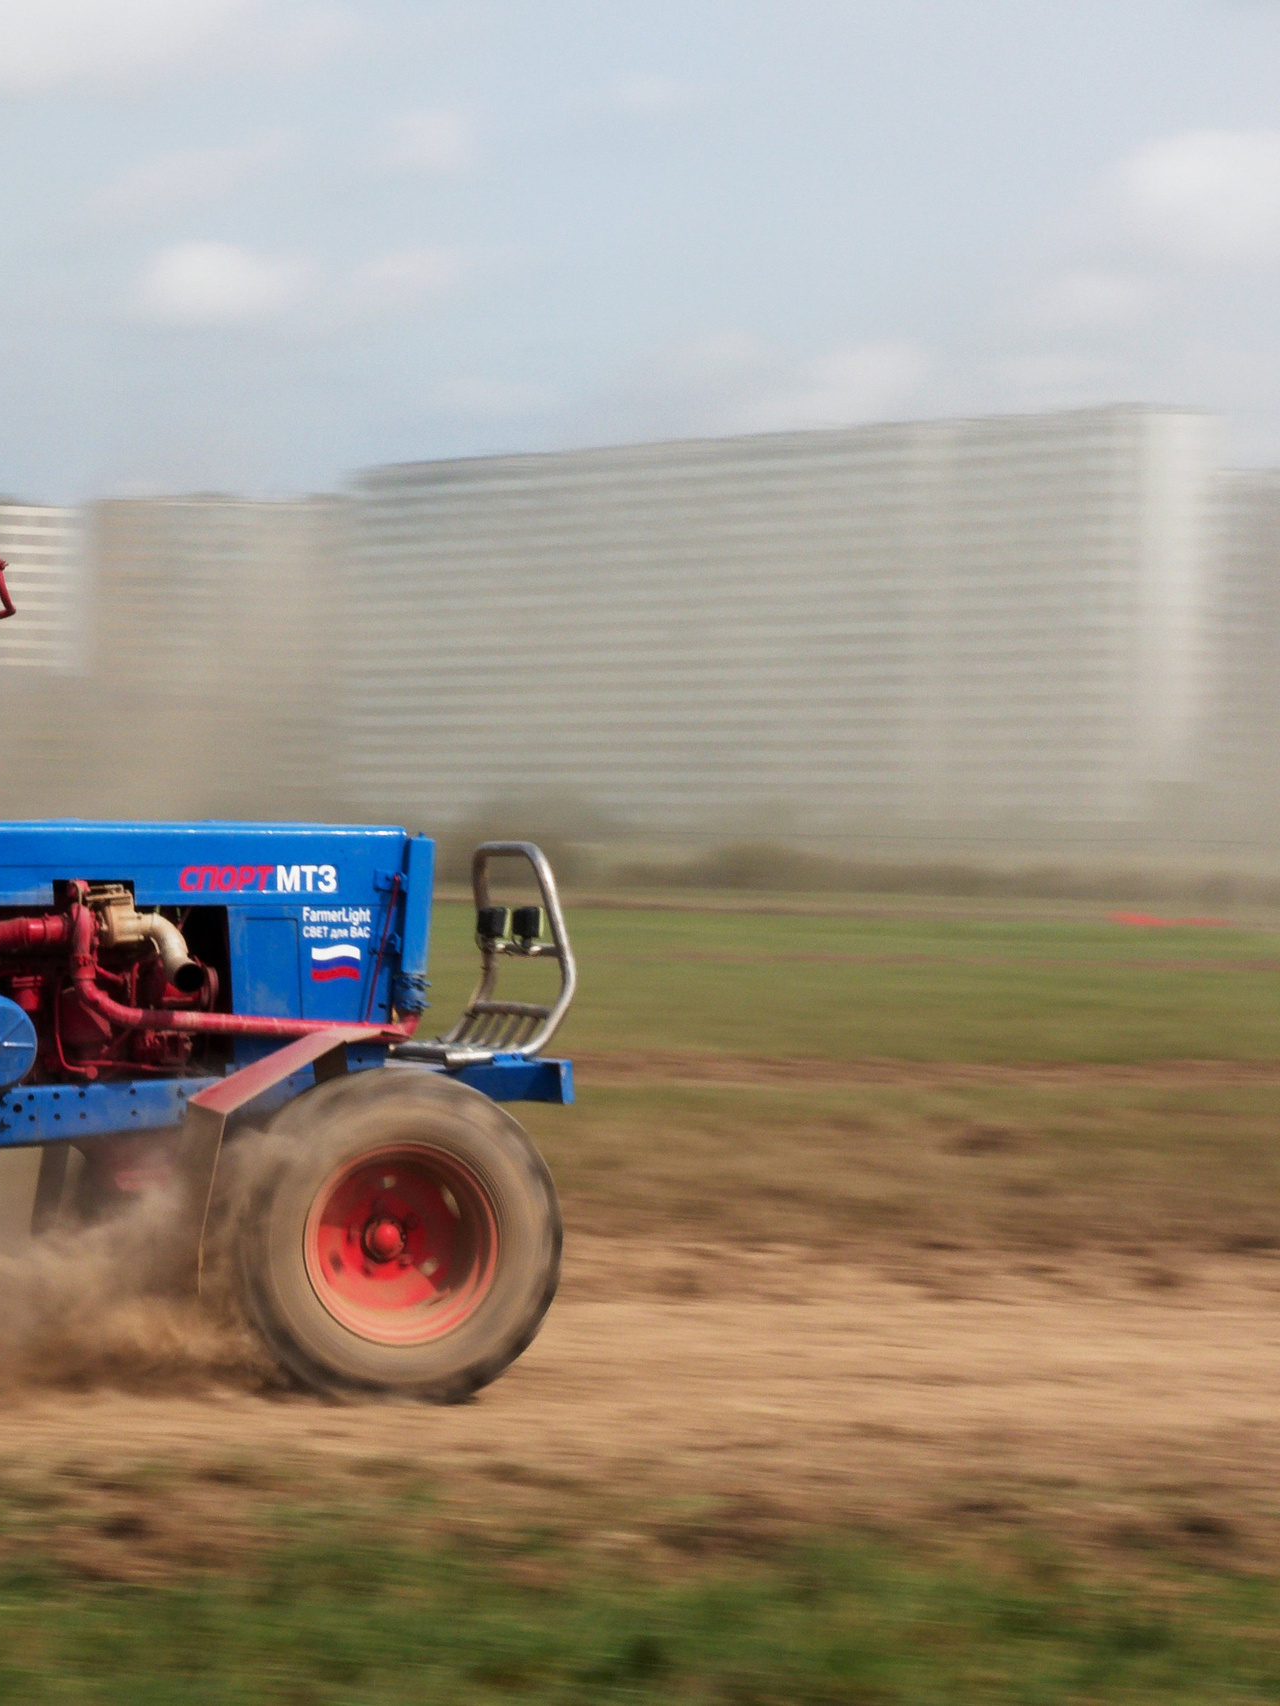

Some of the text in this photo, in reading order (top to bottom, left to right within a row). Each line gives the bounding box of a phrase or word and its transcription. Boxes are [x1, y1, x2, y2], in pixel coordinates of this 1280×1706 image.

[179, 865, 338, 893] СПОРТ МТЗ
[302, 906, 371, 926] FarmerLight
[302, 925, 371, 939] СВЕТ для ВАС
